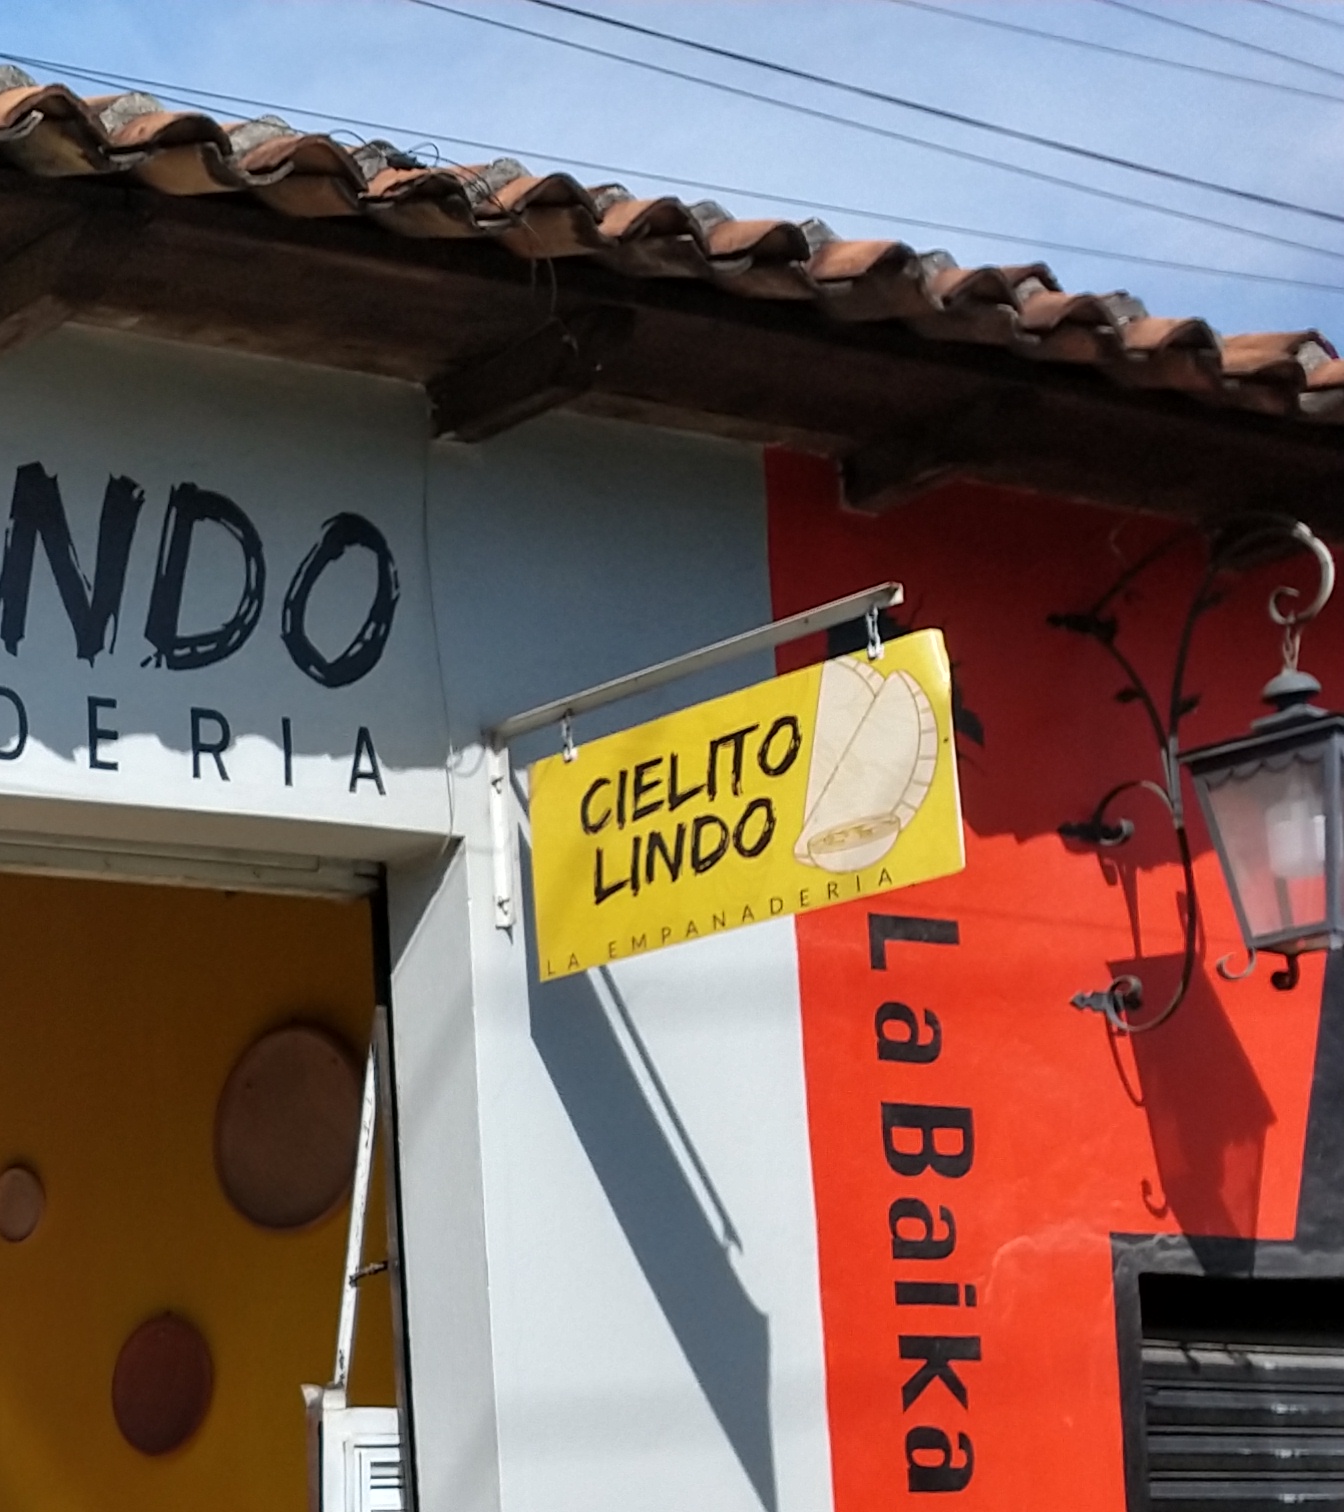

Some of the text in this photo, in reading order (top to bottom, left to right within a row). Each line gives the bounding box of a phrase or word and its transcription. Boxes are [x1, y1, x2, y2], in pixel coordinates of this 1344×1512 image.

[580, 714, 802, 836] CIELITO
[593, 797, 777, 906] LINDO
[546, 867, 894, 977] LA EMPANADERIA
